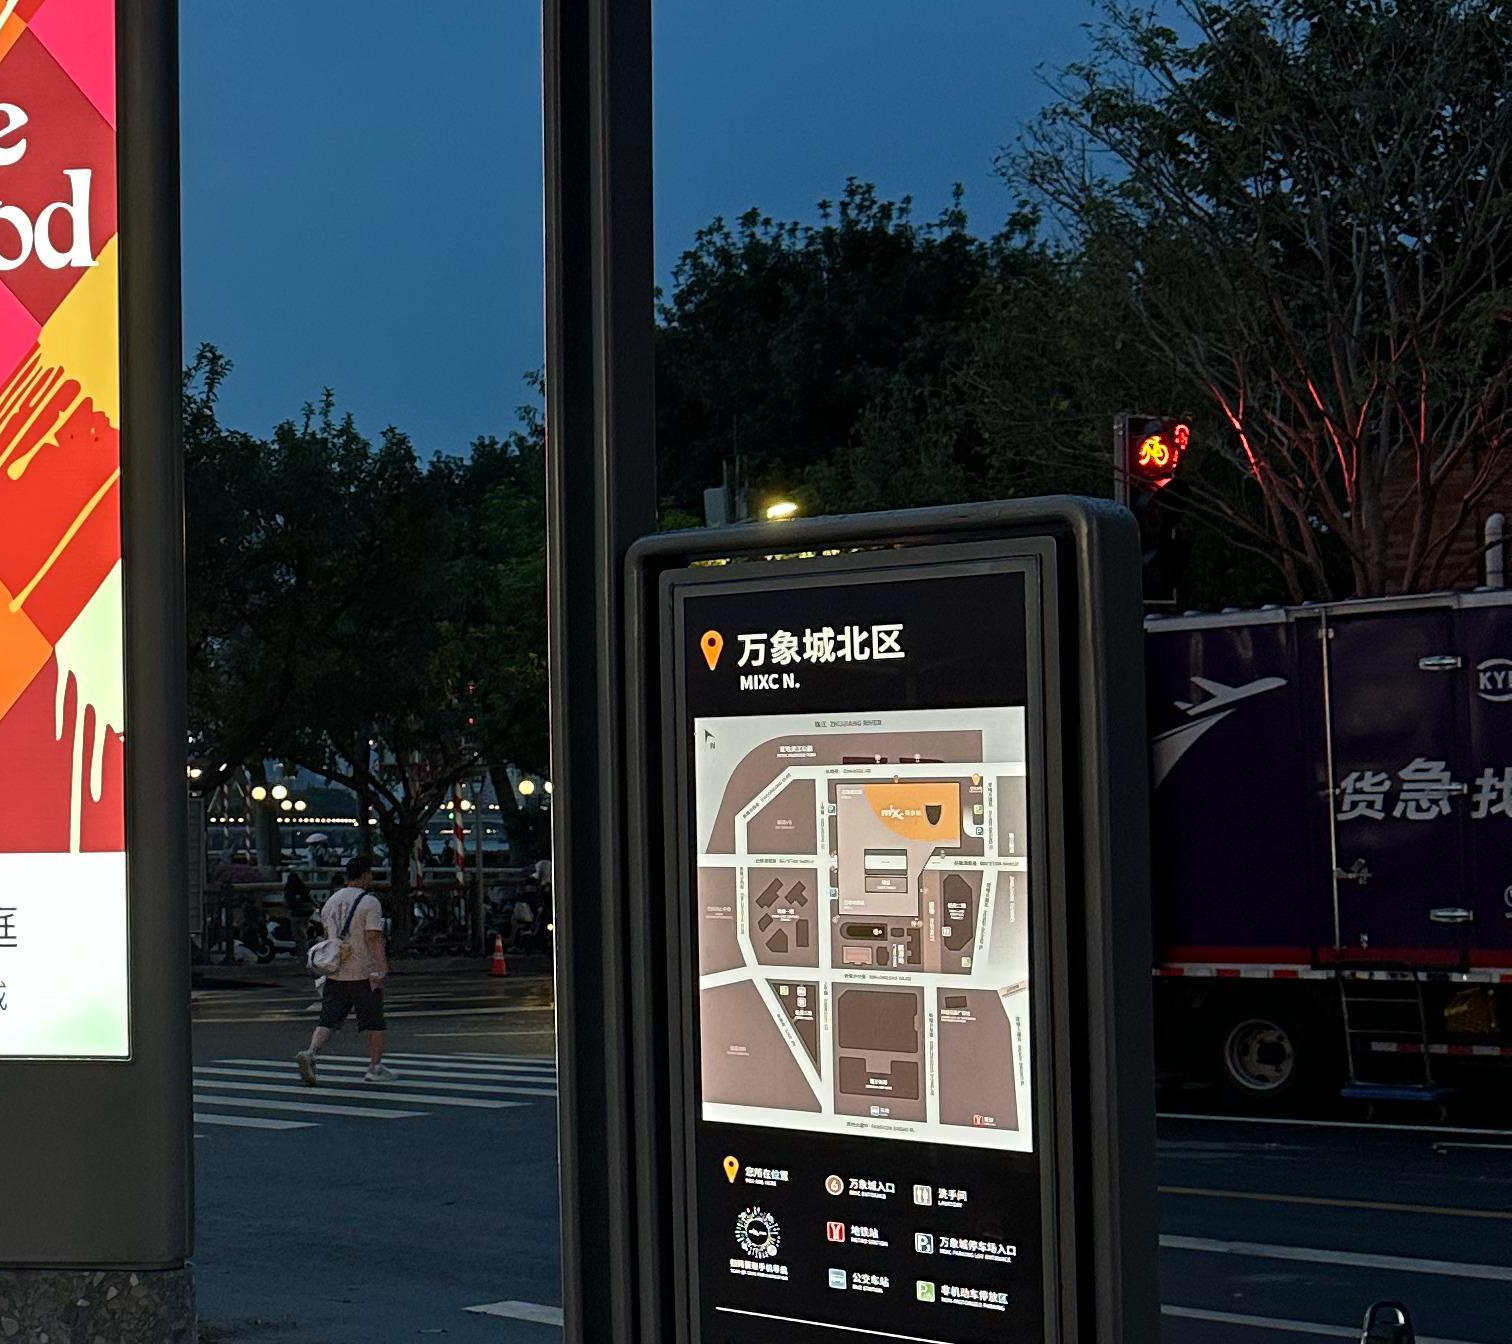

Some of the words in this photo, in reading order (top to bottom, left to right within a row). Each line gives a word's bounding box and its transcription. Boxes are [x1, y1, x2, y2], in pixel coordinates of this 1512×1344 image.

[737, 623, 906, 668] 万象城北区
[740, 674, 780, 691] MIXC
[782, 672, 801, 689] N.
